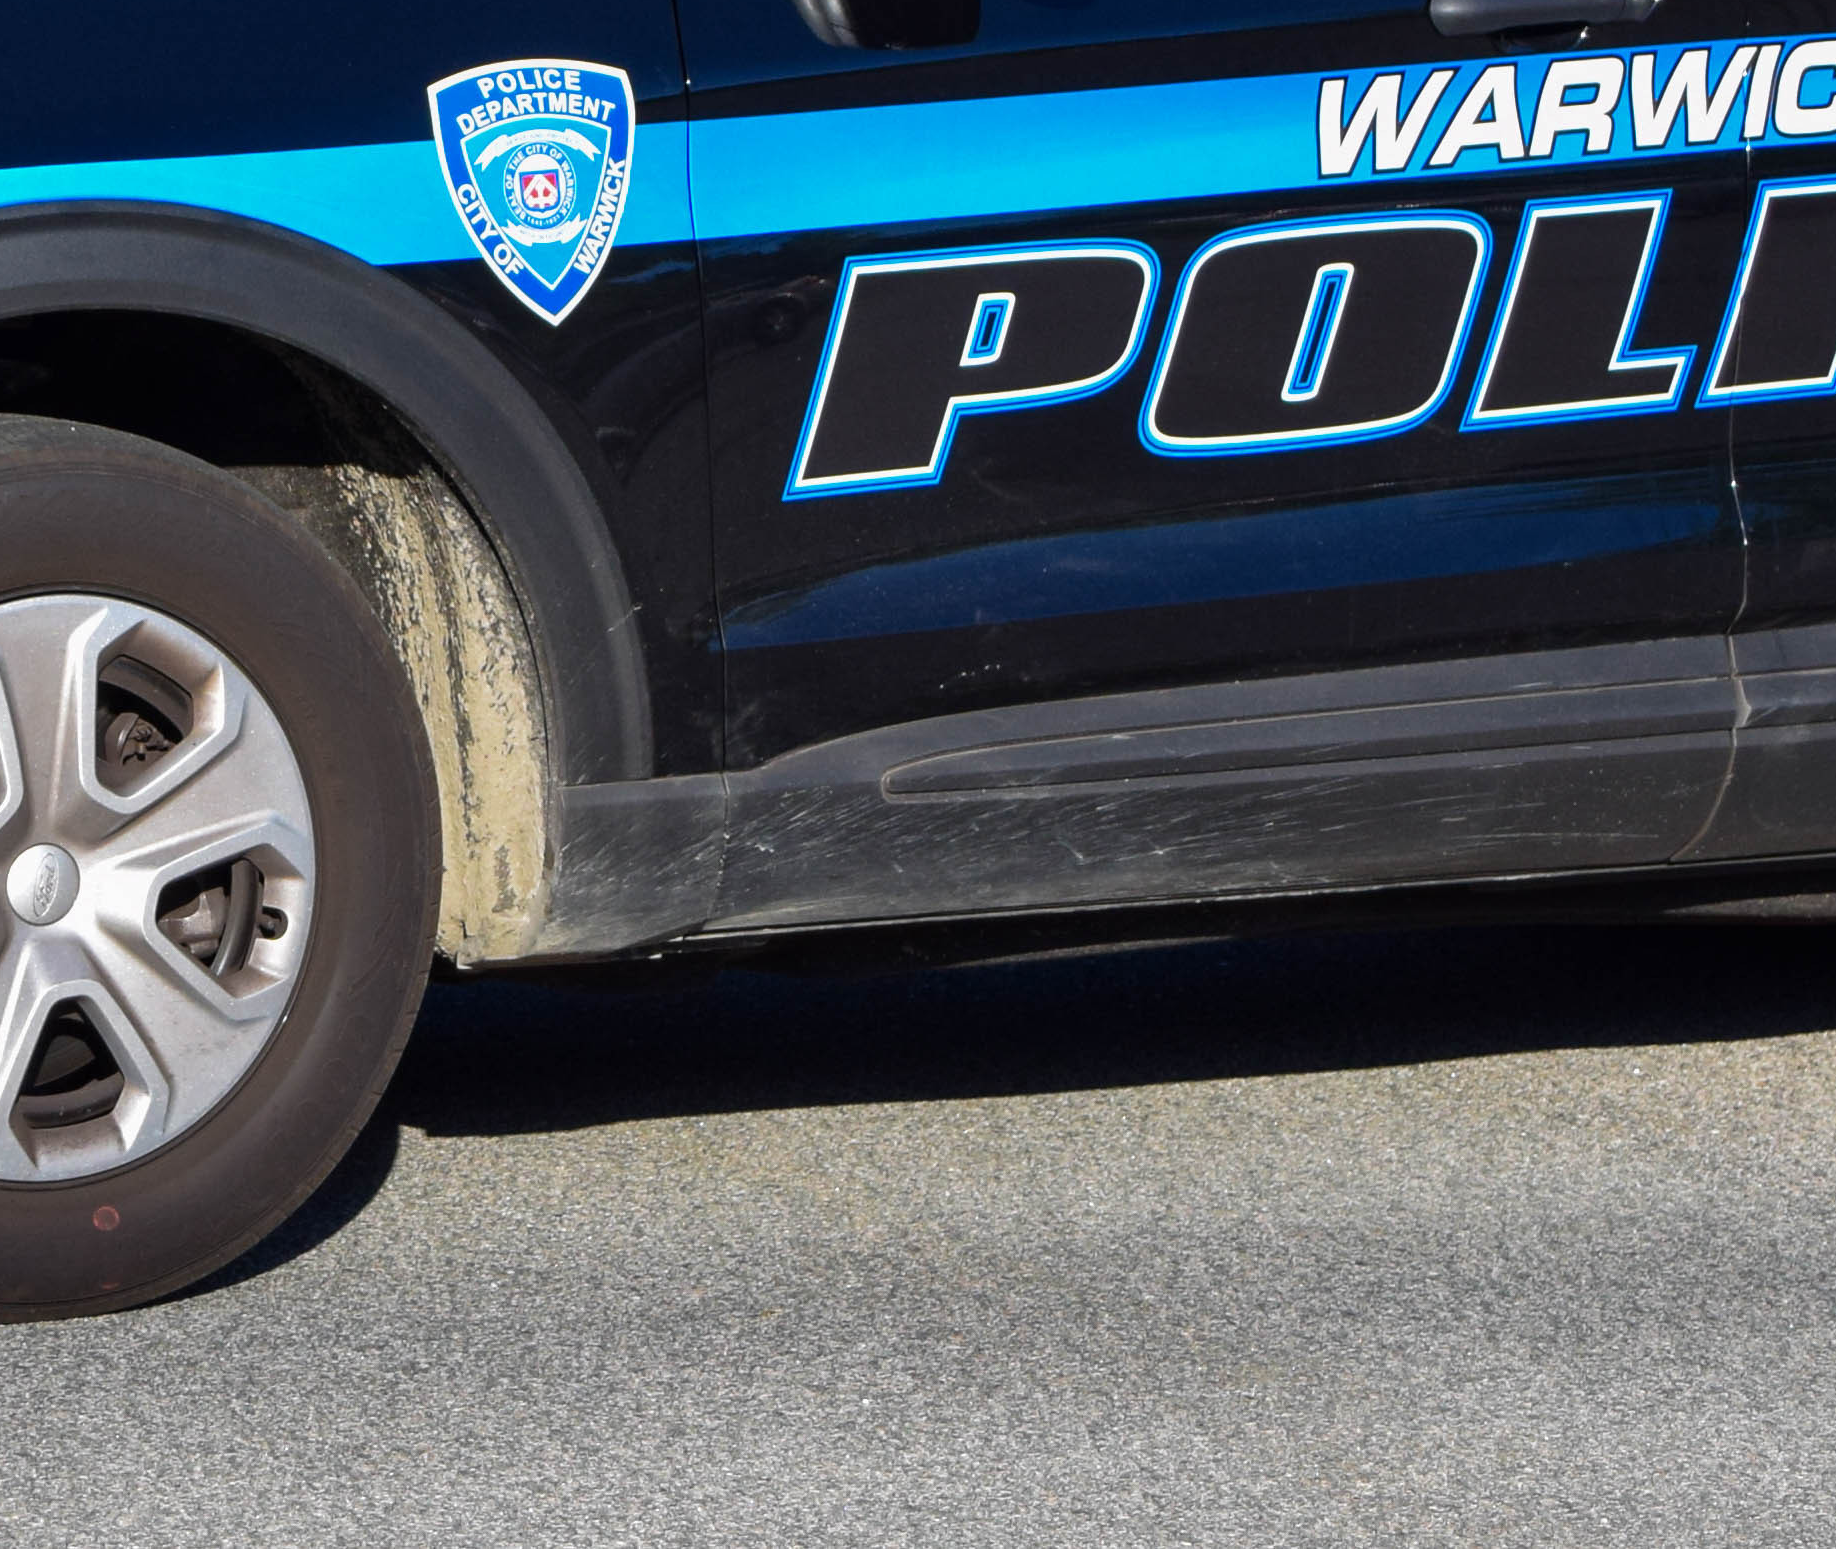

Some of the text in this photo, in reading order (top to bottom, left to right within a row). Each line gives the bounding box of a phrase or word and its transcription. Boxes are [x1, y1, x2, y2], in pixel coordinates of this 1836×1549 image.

[476, 68, 582, 99] POLICE
[456, 91, 616, 135] DEPARTMENT
[526, 144, 549, 155] CITY
[457, 158, 626, 275] CITY OF WARWICK
